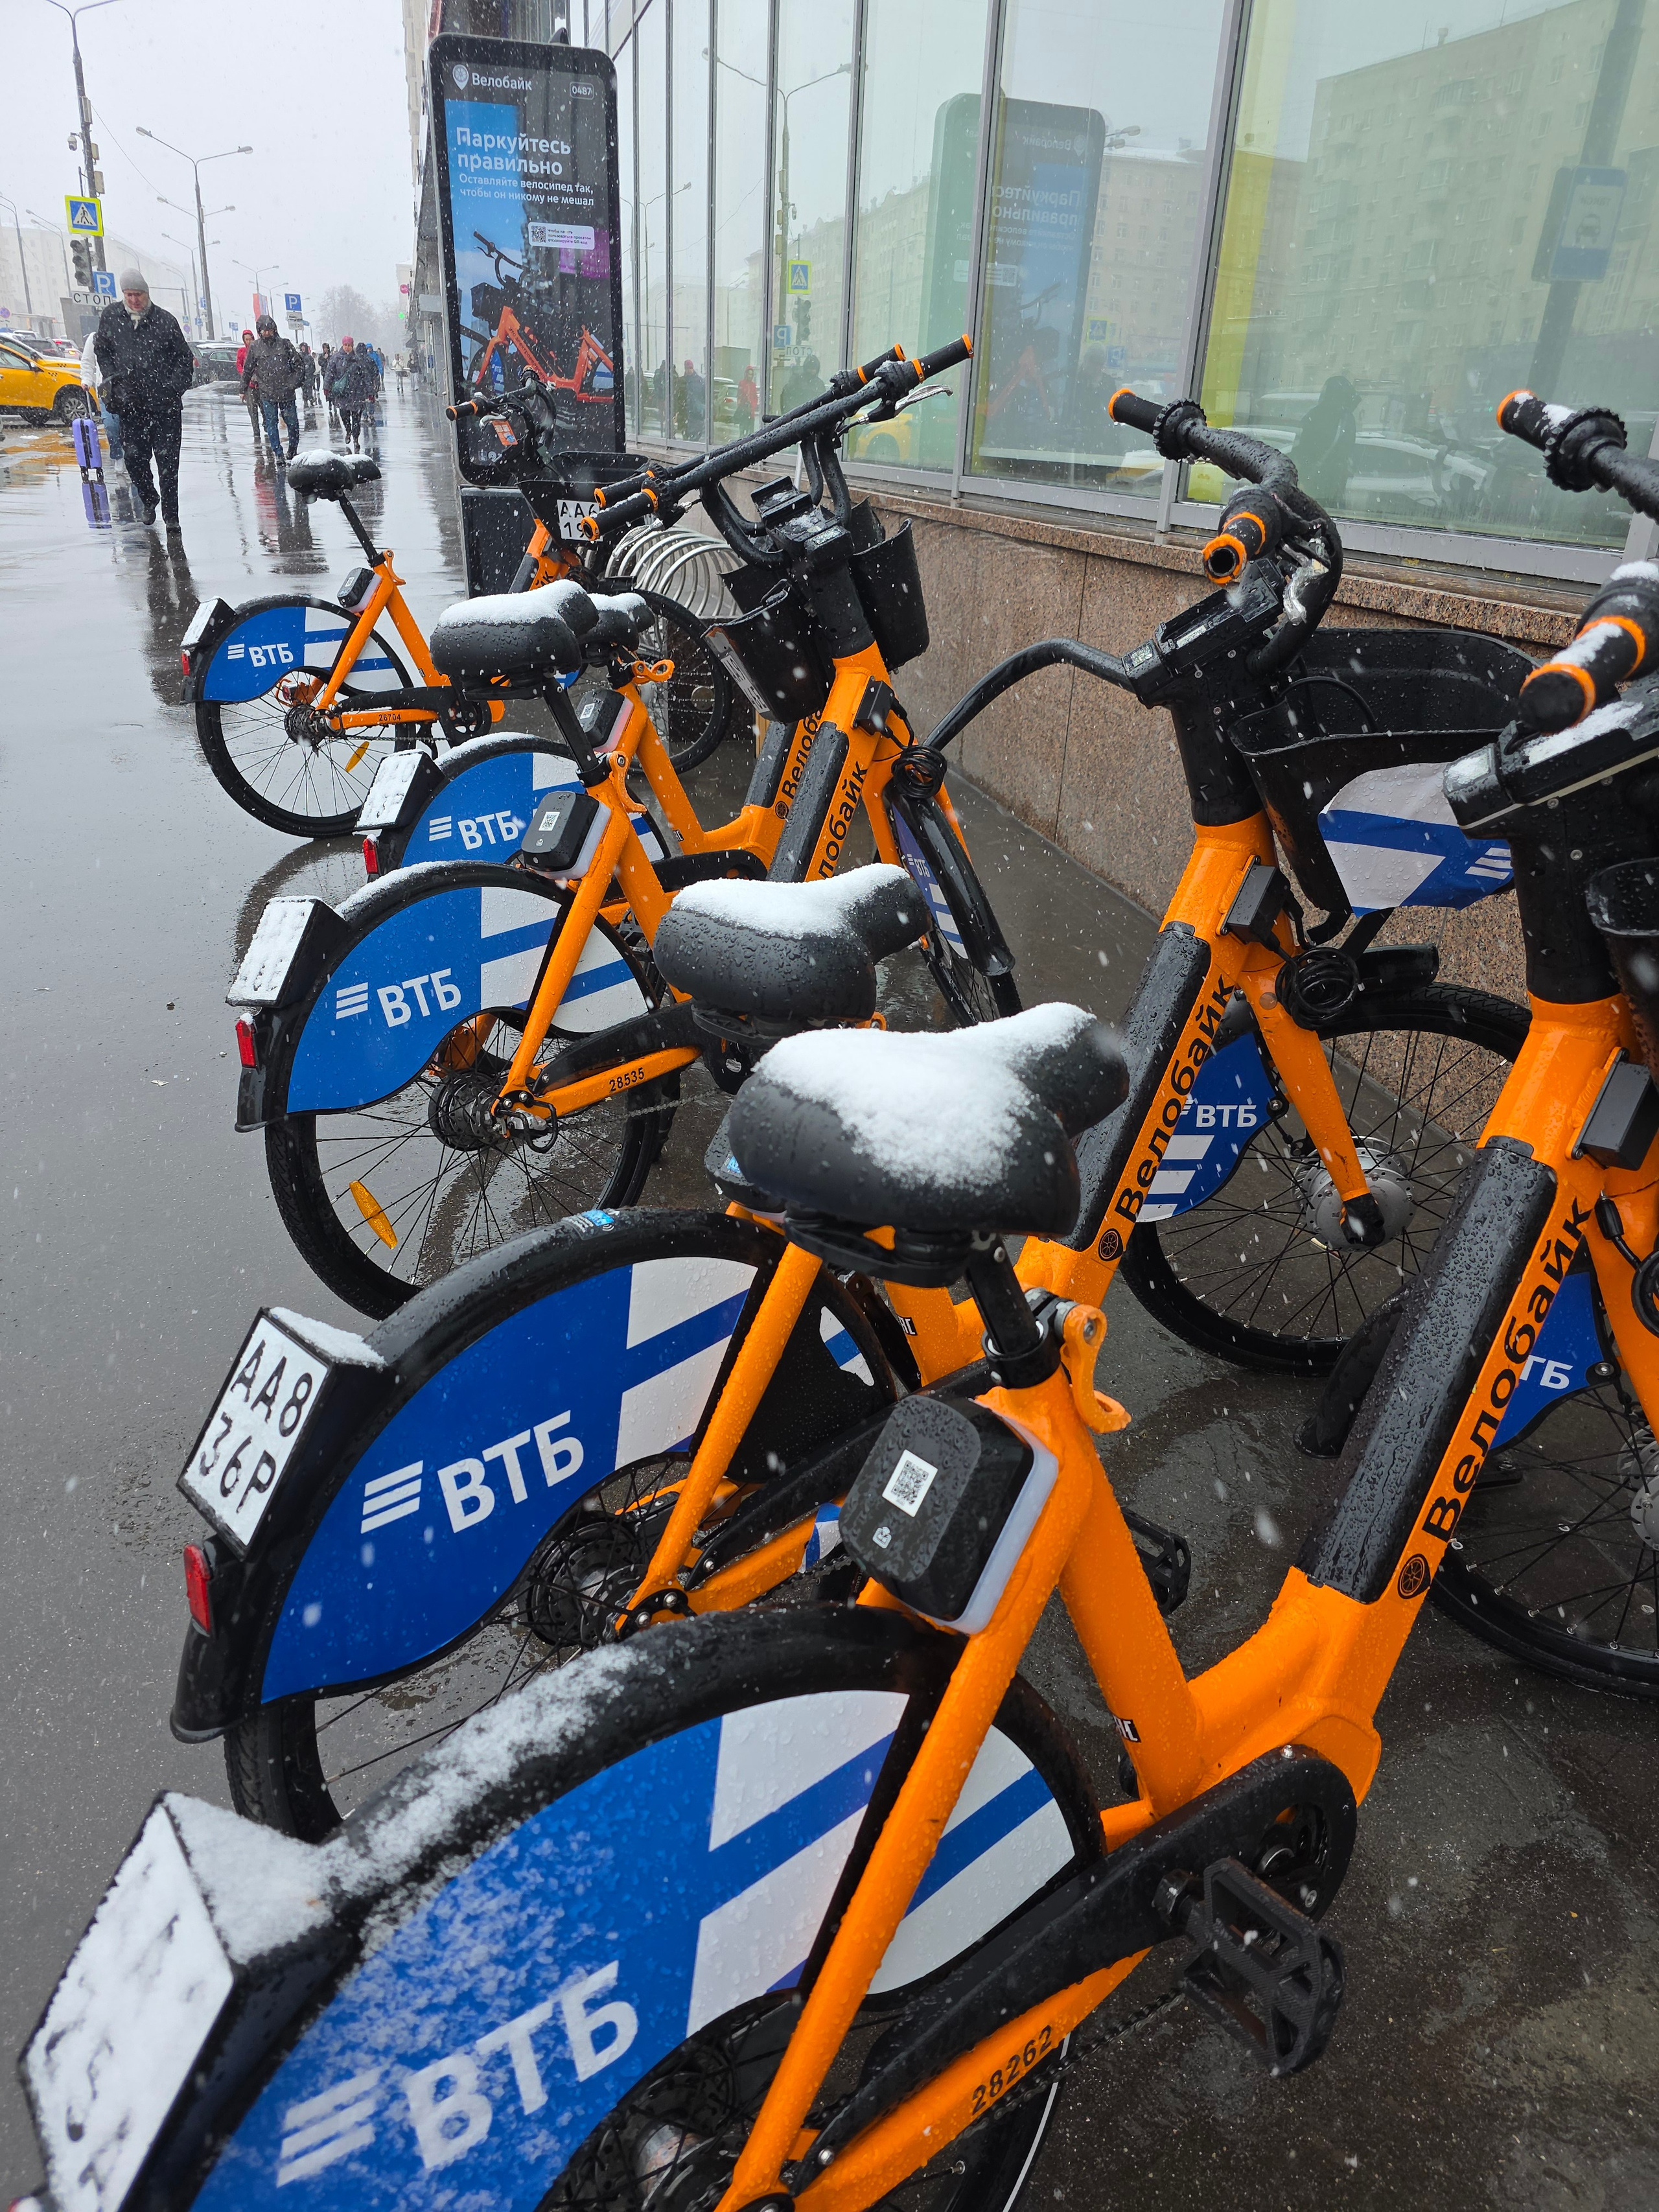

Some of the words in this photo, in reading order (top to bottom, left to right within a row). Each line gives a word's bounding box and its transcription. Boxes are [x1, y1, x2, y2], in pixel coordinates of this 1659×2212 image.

[472, 73, 532, 91] Велобайк
[572, 86, 591, 95] 0487
[456, 126, 571, 155] Паркуйтесь
[458, 154, 563, 175] правильно
[459, 174, 518, 187] Оставляйте
[520, 180, 573, 193] велосипед
[575, 184, 594, 194] так,
[459, 187, 491, 198] чтобы
[494, 191, 506, 200] он
[509, 193, 545, 204] никому
[547, 195, 559, 204] не
[561, 197, 594, 206] мешал
[73, 293, 111, 305] СТОП
[289, 296, 298, 309] P
[248, 642, 294, 668] ВТБ
[781, 712, 822, 799] Велоб
[458, 810, 519, 850] ВТБ
[818, 760, 868, 879] лобайк
[913, 858, 931, 878] ВТБ
[377, 968, 461, 1028] ВТБ
[609, 1067, 644, 1092] 28535
[1114, 973, 1235, 1224] Велобайк
[1196, 1104, 1257, 1128] ВТБ
[1422, 1196, 1594, 1544] Велобайк
[1519, 1354, 1573, 1390] ТБ
[230, 1339, 312, 1438] АА8
[199, 1411, 276, 1514] 36Р
[437, 1410, 584, 1533] ВТБ
[404, 1959, 639, 2169] ВТБ
[971, 2025, 1052, 2116] 28262
